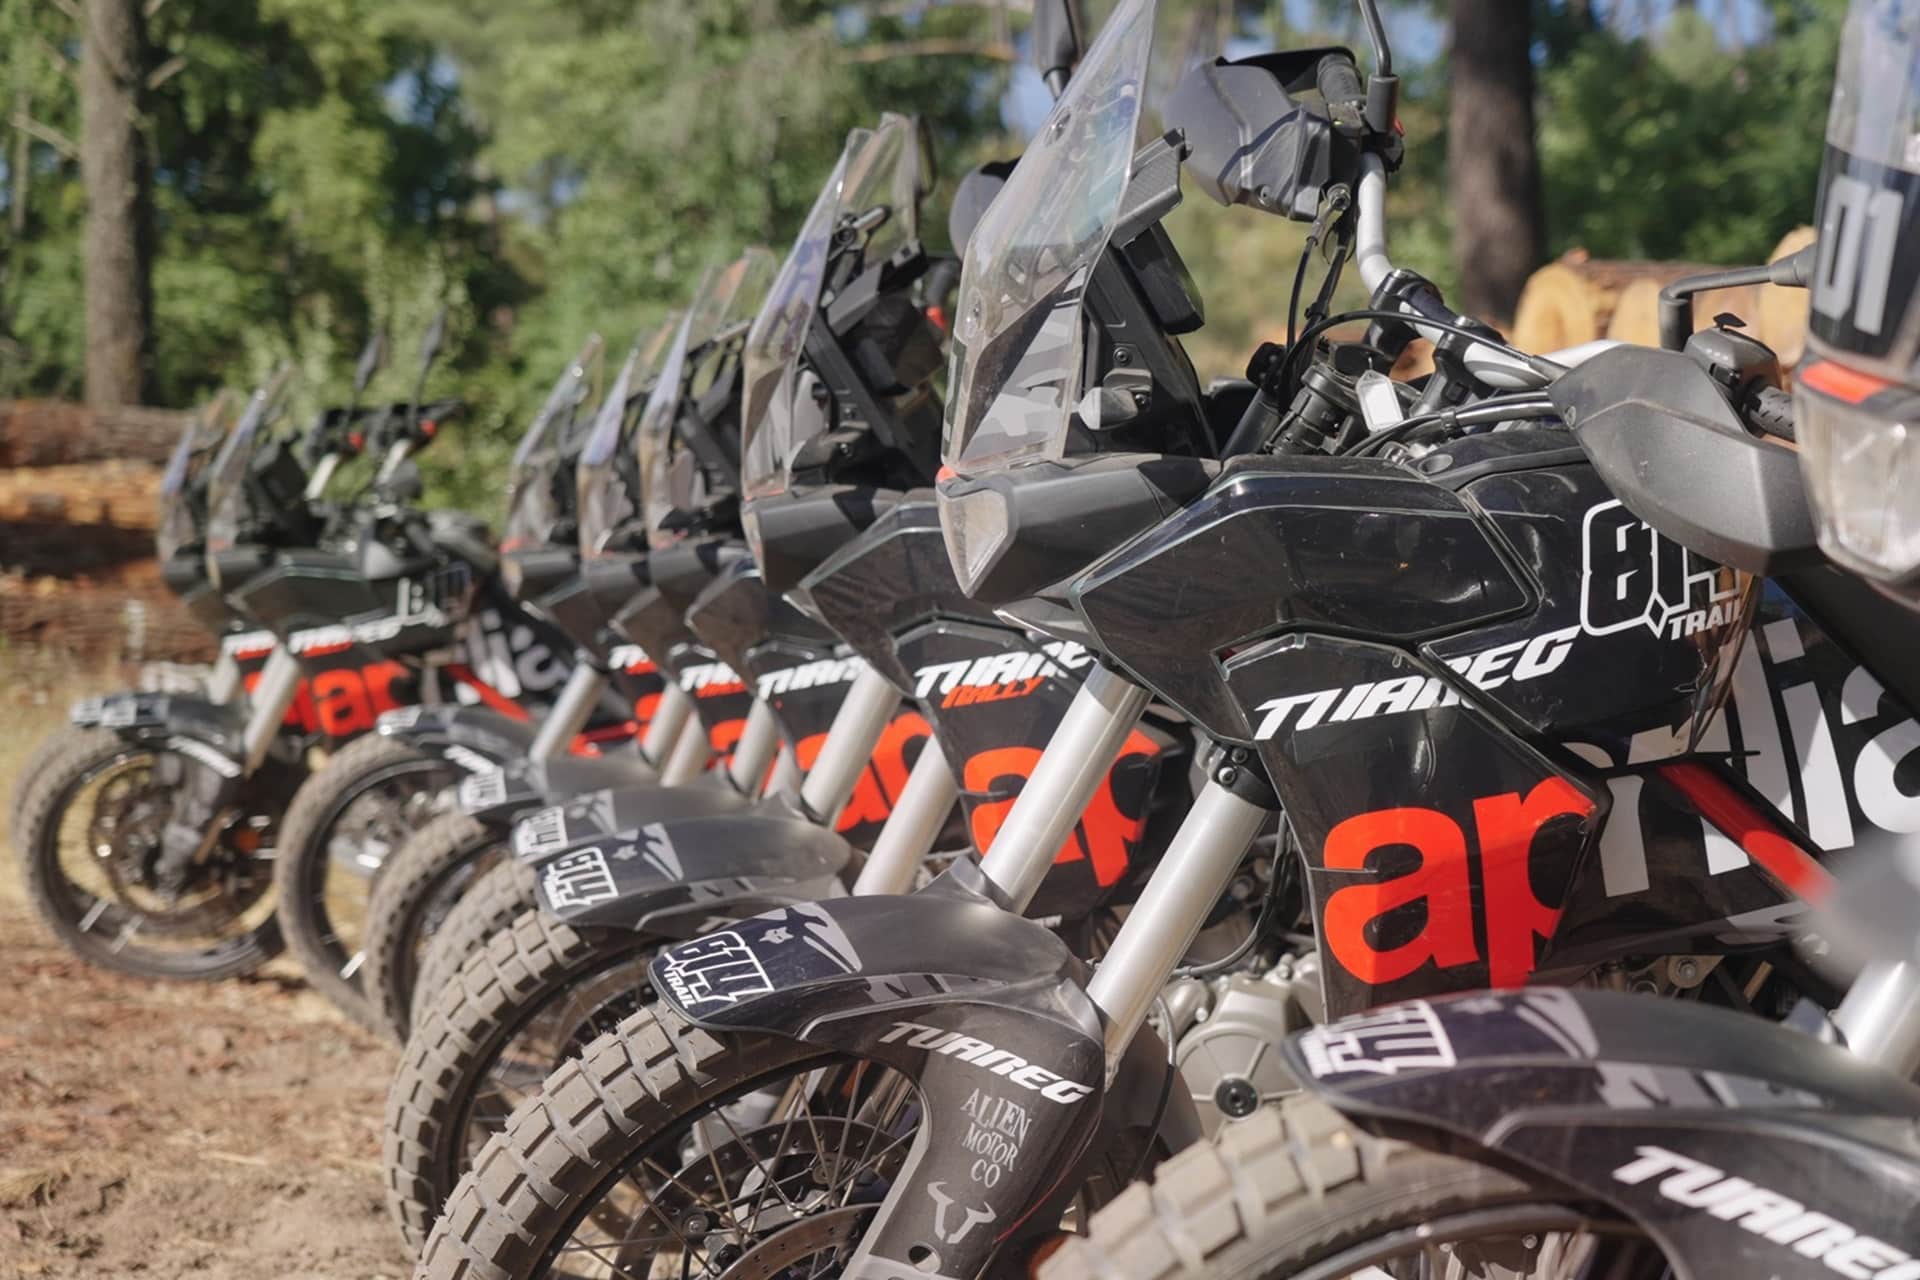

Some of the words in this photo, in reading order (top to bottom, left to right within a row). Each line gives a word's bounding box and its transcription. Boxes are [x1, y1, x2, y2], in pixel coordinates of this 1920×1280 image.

[940, 676, 1047, 710] RALLY
[1253, 624, 1582, 741] TUAREG
[663, 968, 698, 1010] TRAIL
[877, 1021, 1096, 1105] TUAREG
[959, 1087, 1033, 1149] ALIEN
[961, 1122, 1019, 1173] MOTOR
[970, 1158, 1002, 1190] CO
